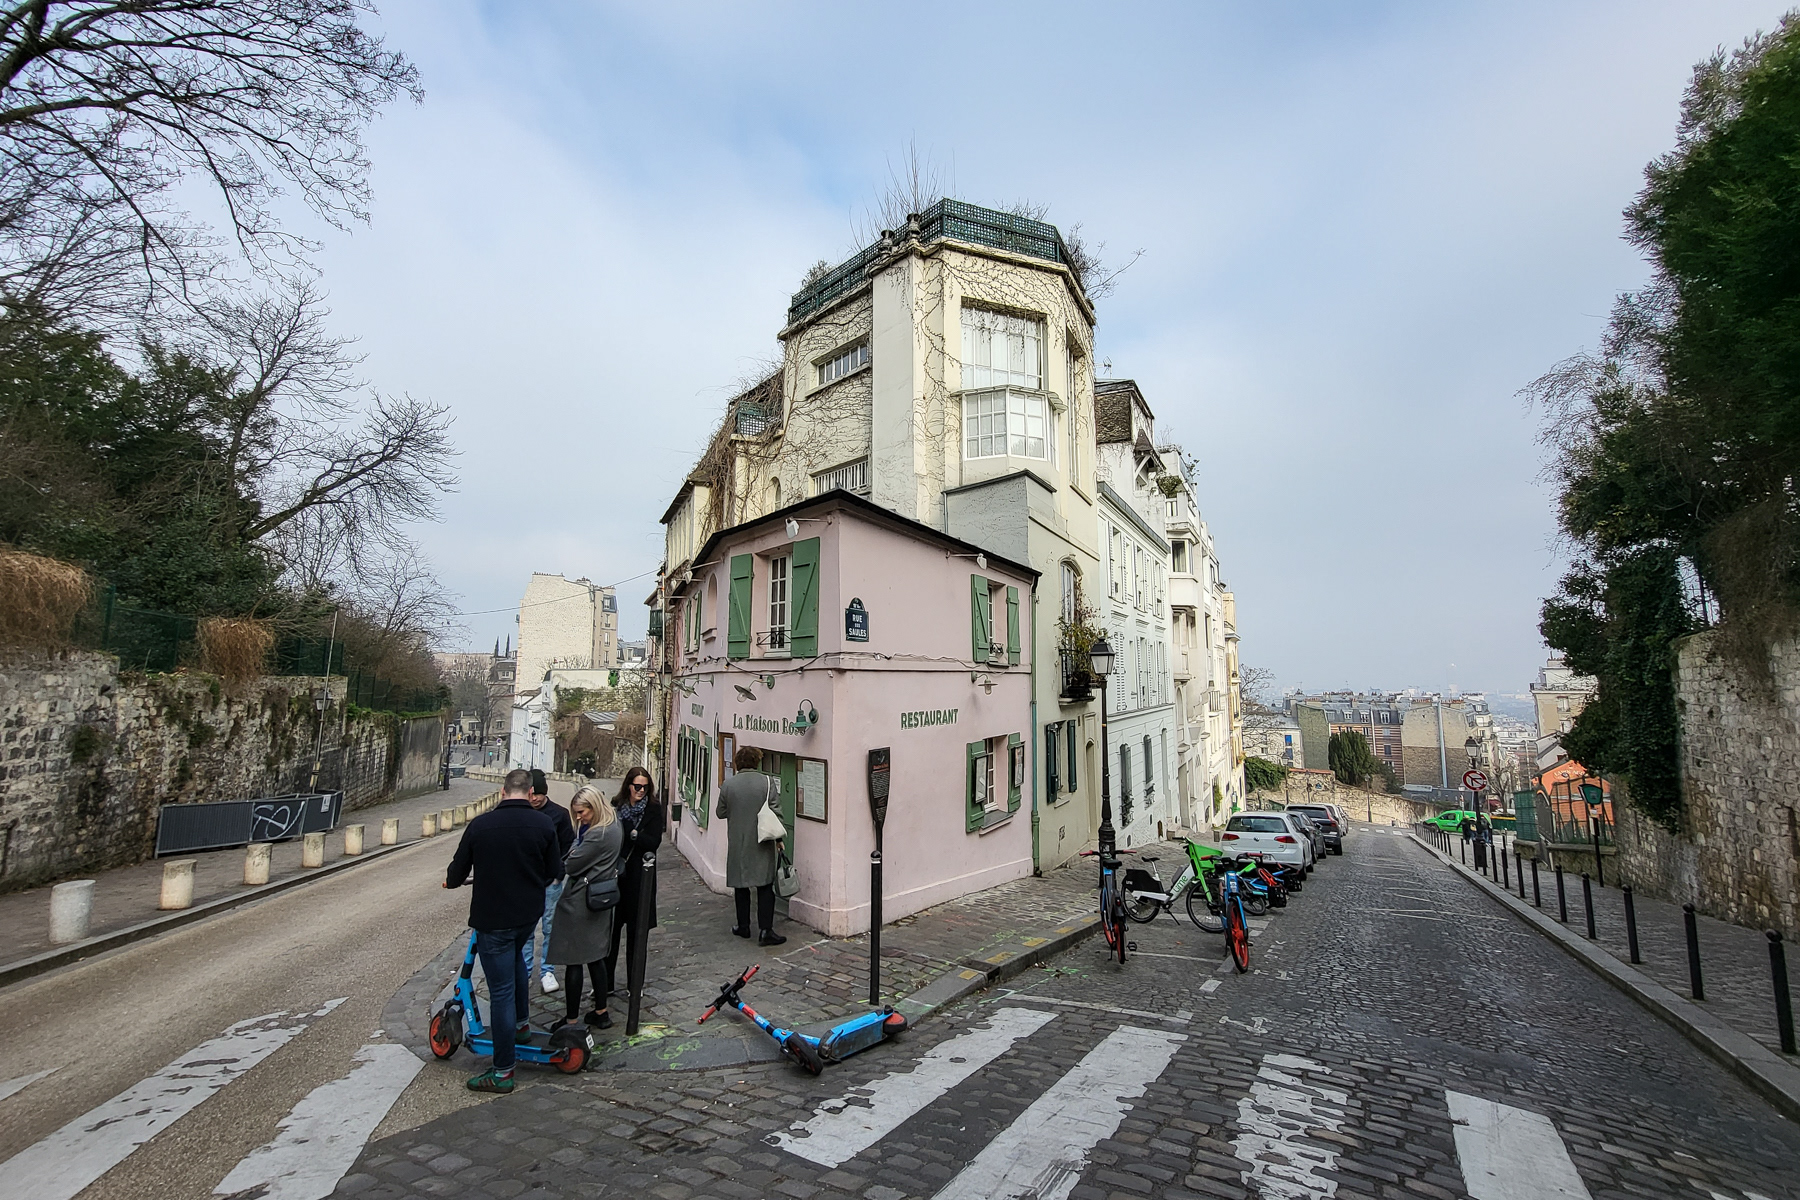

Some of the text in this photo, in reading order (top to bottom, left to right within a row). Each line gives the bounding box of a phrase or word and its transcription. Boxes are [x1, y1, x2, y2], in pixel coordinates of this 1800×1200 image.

[852, 614, 863, 623] RUE
[848, 627, 867, 637] SAULES
[732, 713, 743, 730] La
[745, 714, 779, 734] Maison
[901, 708, 959, 730] RESTAURANT
[1173, 875, 1189, 893] Lime
